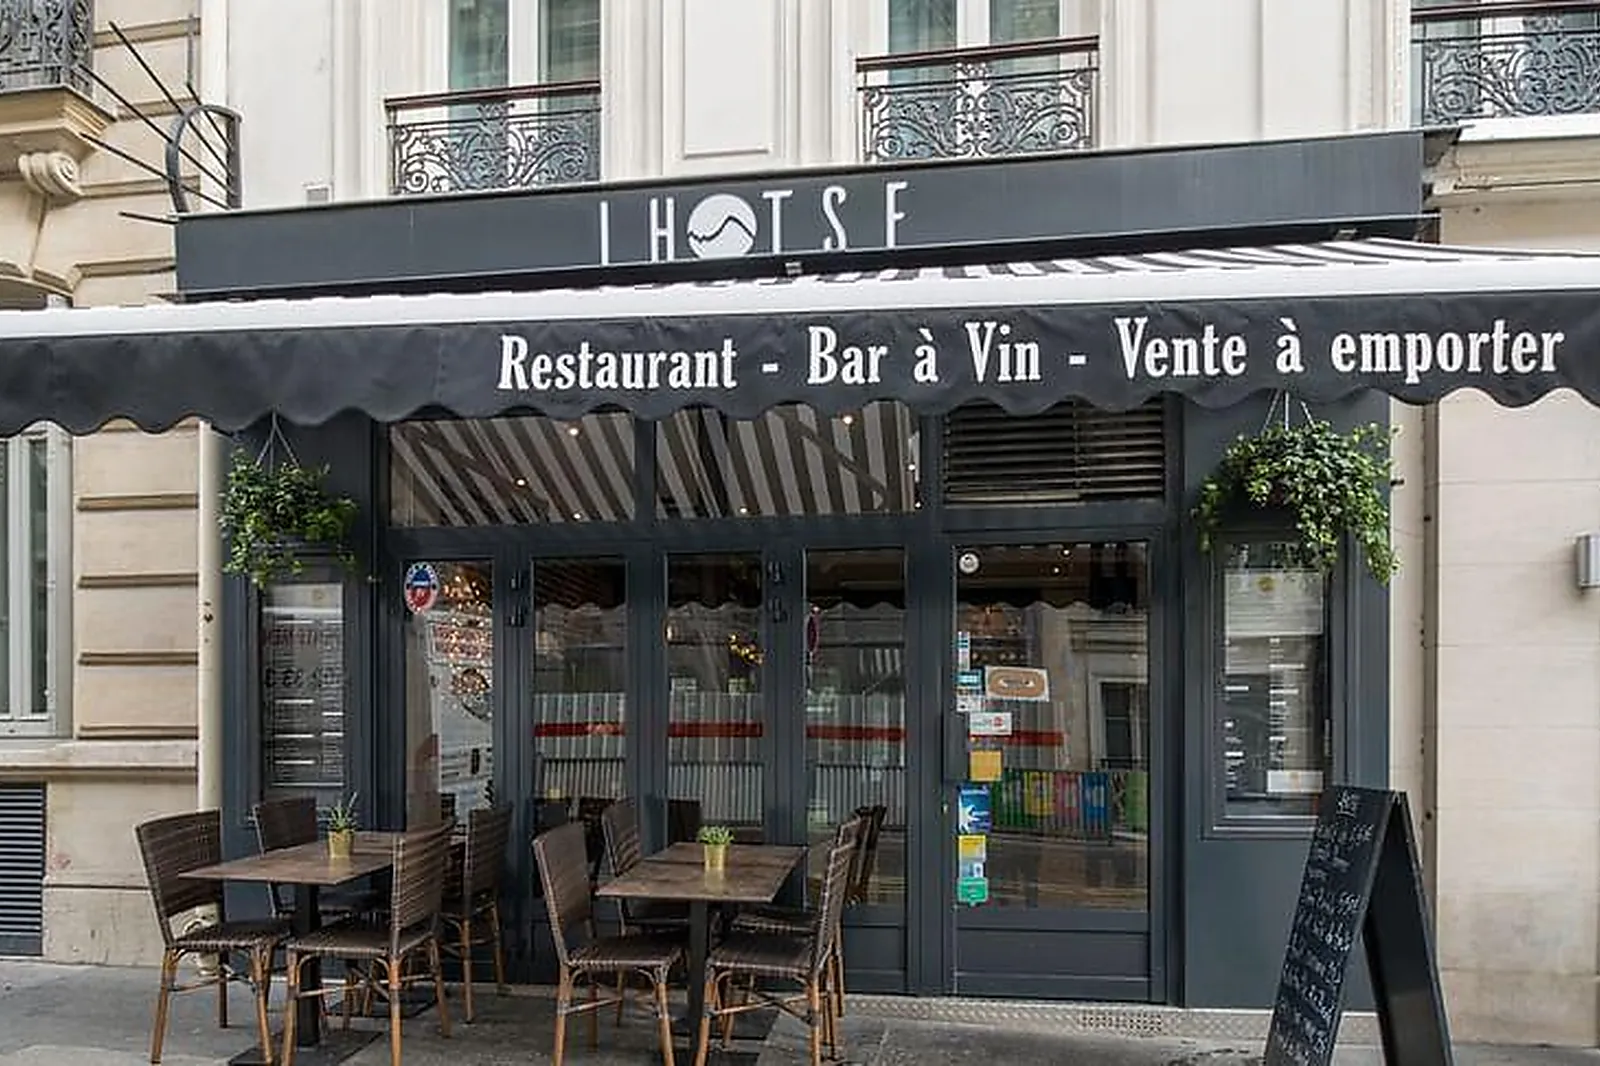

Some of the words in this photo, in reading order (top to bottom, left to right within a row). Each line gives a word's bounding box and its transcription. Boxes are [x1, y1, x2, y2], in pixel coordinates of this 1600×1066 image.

[498, 334, 737, 391] Restaurant
[762, 363, 779, 372] -
[807, 325, 887, 386] Bar
[913, 328, 939, 383] à
[965, 320, 1041, 383] Vin
[1068, 355, 1087, 365] -
[1115, 316, 1248, 379] Vente
[1275, 318, 1304, 373] à
[1331, 320, 1565, 385] emporter
